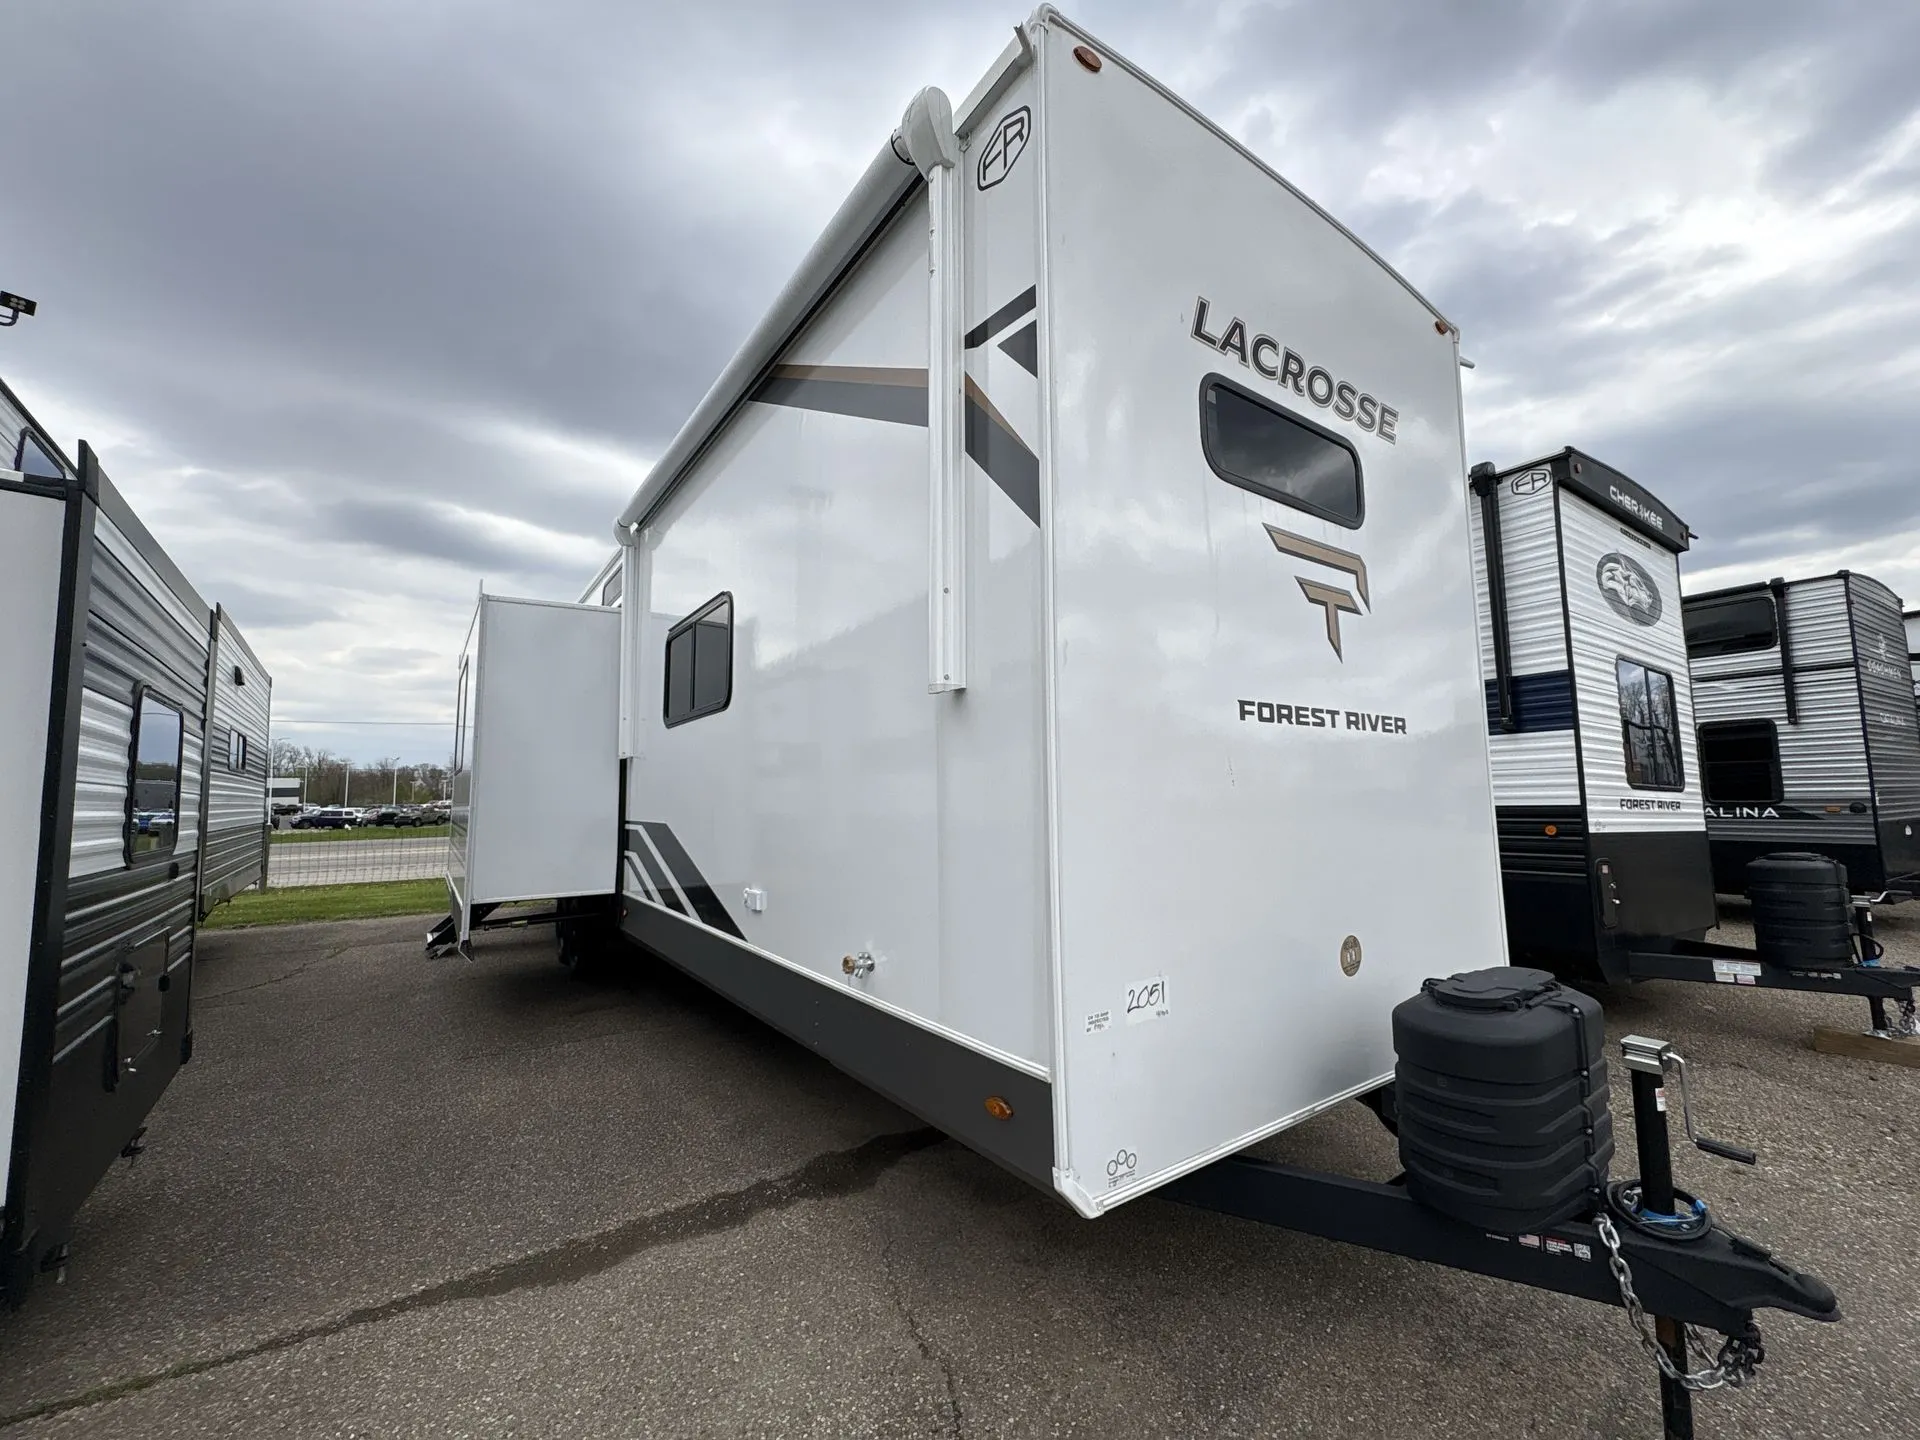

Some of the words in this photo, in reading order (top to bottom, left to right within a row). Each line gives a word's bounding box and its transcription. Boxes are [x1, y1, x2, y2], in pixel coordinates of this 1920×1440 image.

[1190, 295, 1399, 446] LACROSSE
[1237, 699, 1341, 729] FOREST
[1344, 710, 1408, 735] RIVER
[1619, 798, 1656, 811] FOREST
[1657, 799, 1682, 812] RIVER
[1127, 980, 1165, 1014] 2051
